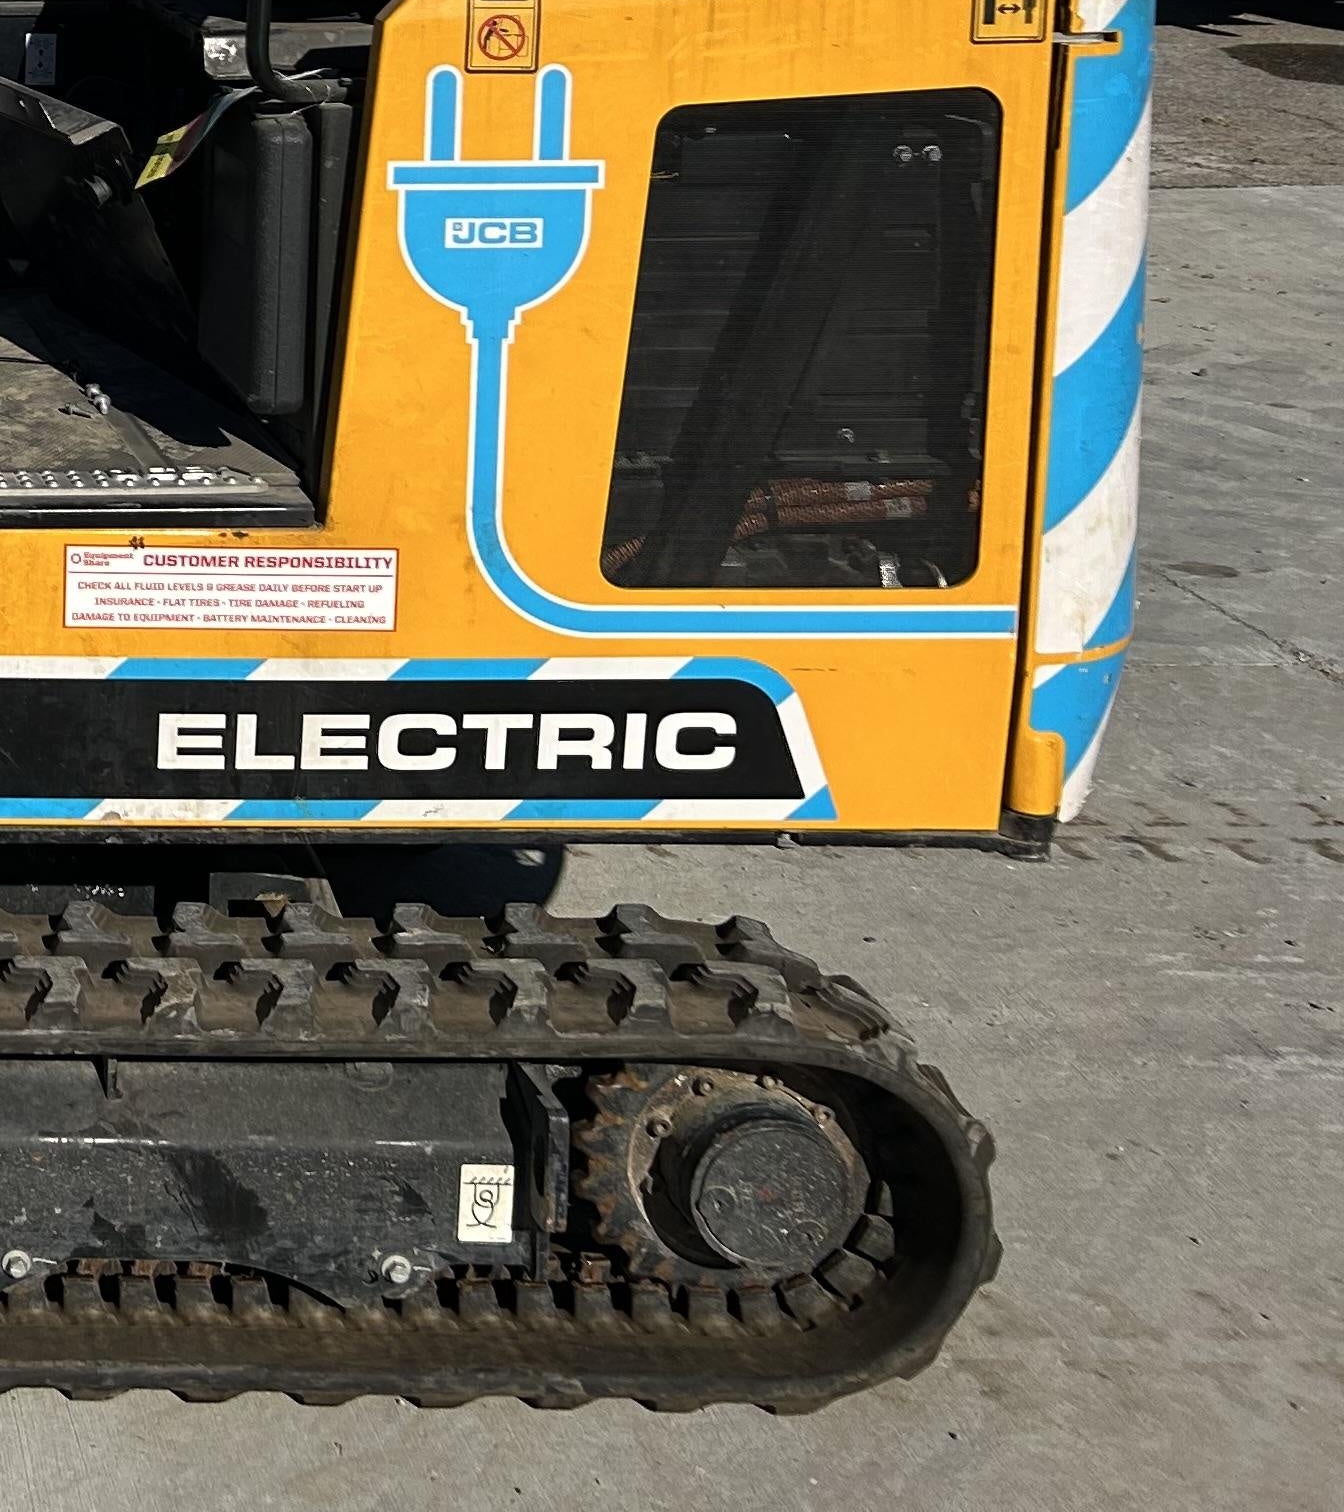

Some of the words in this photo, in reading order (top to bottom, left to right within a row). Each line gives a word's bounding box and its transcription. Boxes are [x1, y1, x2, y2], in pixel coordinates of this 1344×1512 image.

[452, 222, 538, 244] JCB
[143, 554, 239, 568] CUSTOMER
[244, 555, 393, 569] RESPONSIBILITY
[77, 581, 111, 591] CHECK
[113, 581, 131, 591] ALL
[134, 582, 165, 591] FLUID
[167, 582, 206, 592] LEVELS
[215, 583, 256, 593] GREASE
[258, 584, 289, 593] DAILY
[291, 584, 331, 593] BEFORE
[333, 584, 365, 593] START
[368, 584, 383, 593] UP
[94, 597, 155, 606] INSURANCE
[162, 598, 186, 607] FLAT
[188, 598, 220, 607] TIRES
[228, 599, 252, 608] TIRE
[255, 599, 299, 608] DAMAGE
[307, 599, 365, 609] REFUELING
[71, 612, 115, 621] DAMAGE
[117, 612, 131, 622] TO
[133, 612, 194, 622] EQUIPMENT
[202, 613, 248, 623] BATTERY
[250, 615, 326, 624] MAINTENANCE
[334, 615, 386, 625] CLEANING
[155, 711, 738, 772] ELECTRIC
